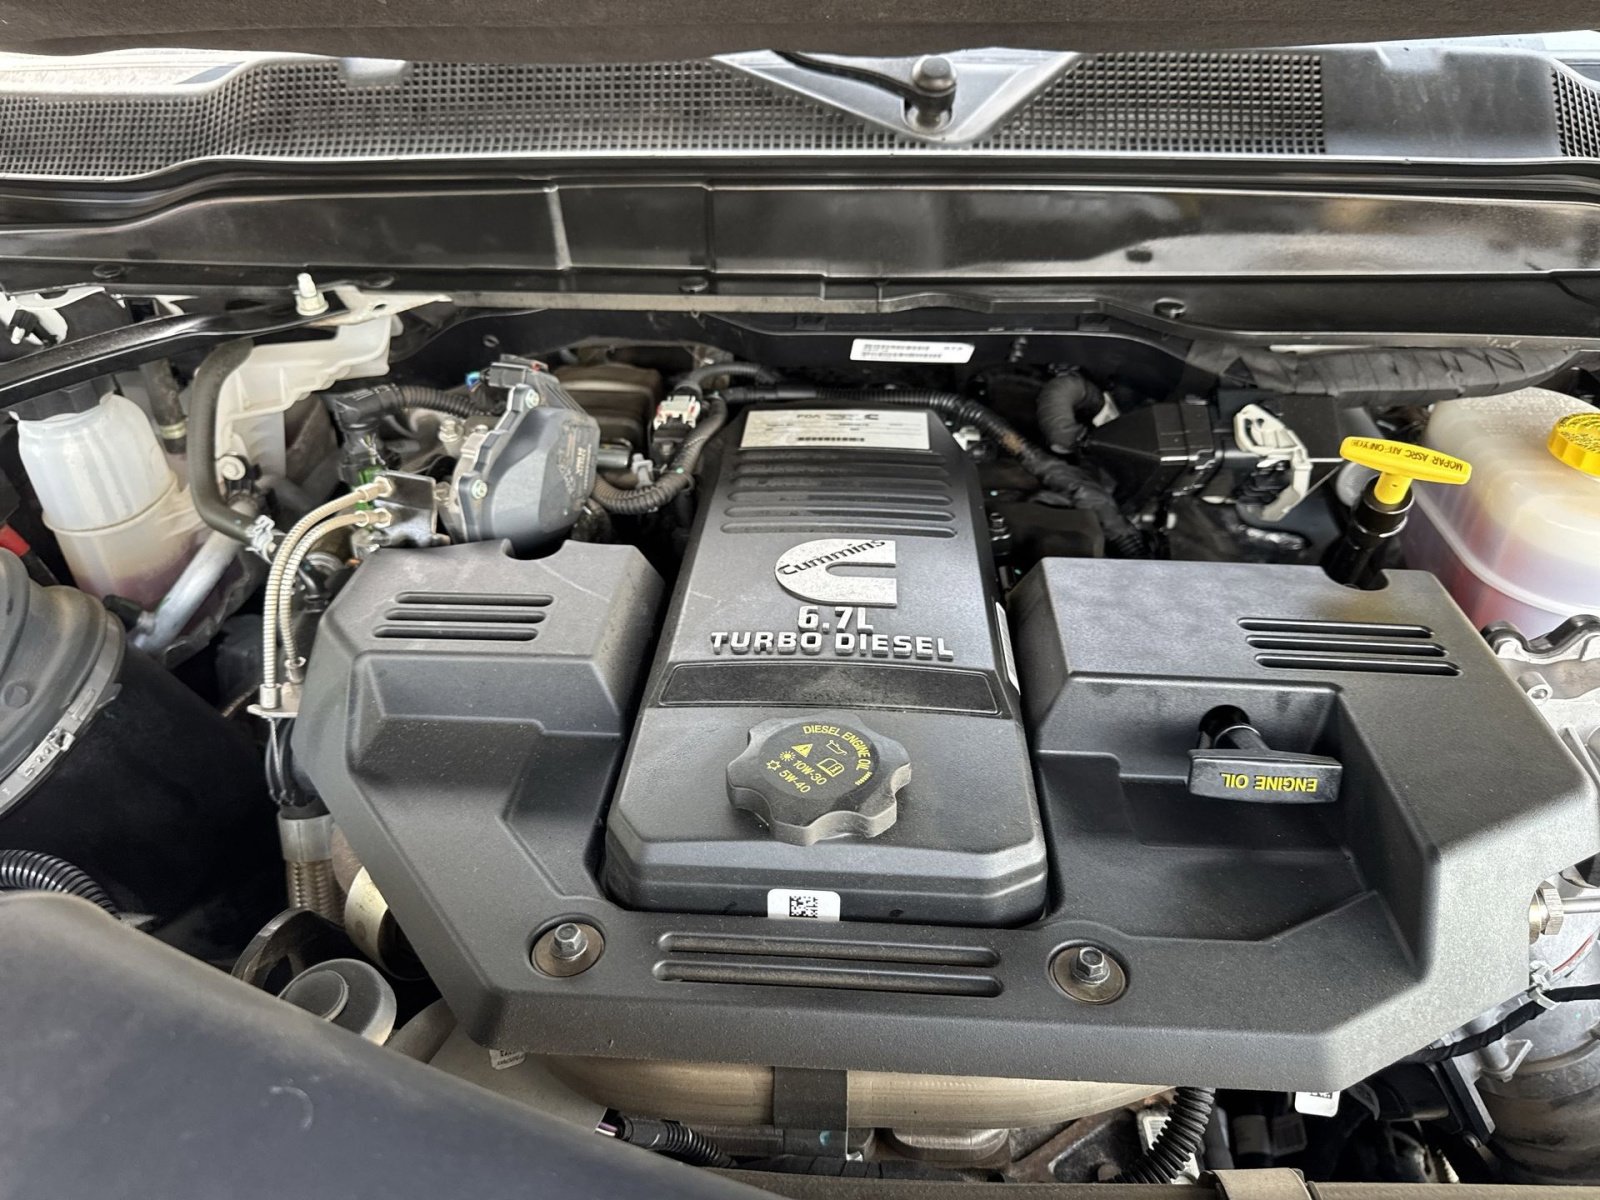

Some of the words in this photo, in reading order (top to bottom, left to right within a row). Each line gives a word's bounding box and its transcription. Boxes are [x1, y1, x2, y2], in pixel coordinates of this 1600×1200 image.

[1431, 457, 1464, 472] MOPAR
[777, 539, 886, 576] Cummins
[797, 605, 874, 634] 6.7L
[710, 631, 823, 656] TURBO
[835, 632, 954, 660] DIESEL
[803, 724, 841, 737] DIESEL
[841, 731, 871, 758] ENGINE
[793, 759, 827, 786] 10W-30
[855, 758, 872, 771] OIL
[779, 769, 811, 793] 5W-40
[1220, 772, 1249, 789] OIL
[1254, 774, 1319, 792] ENGINE
